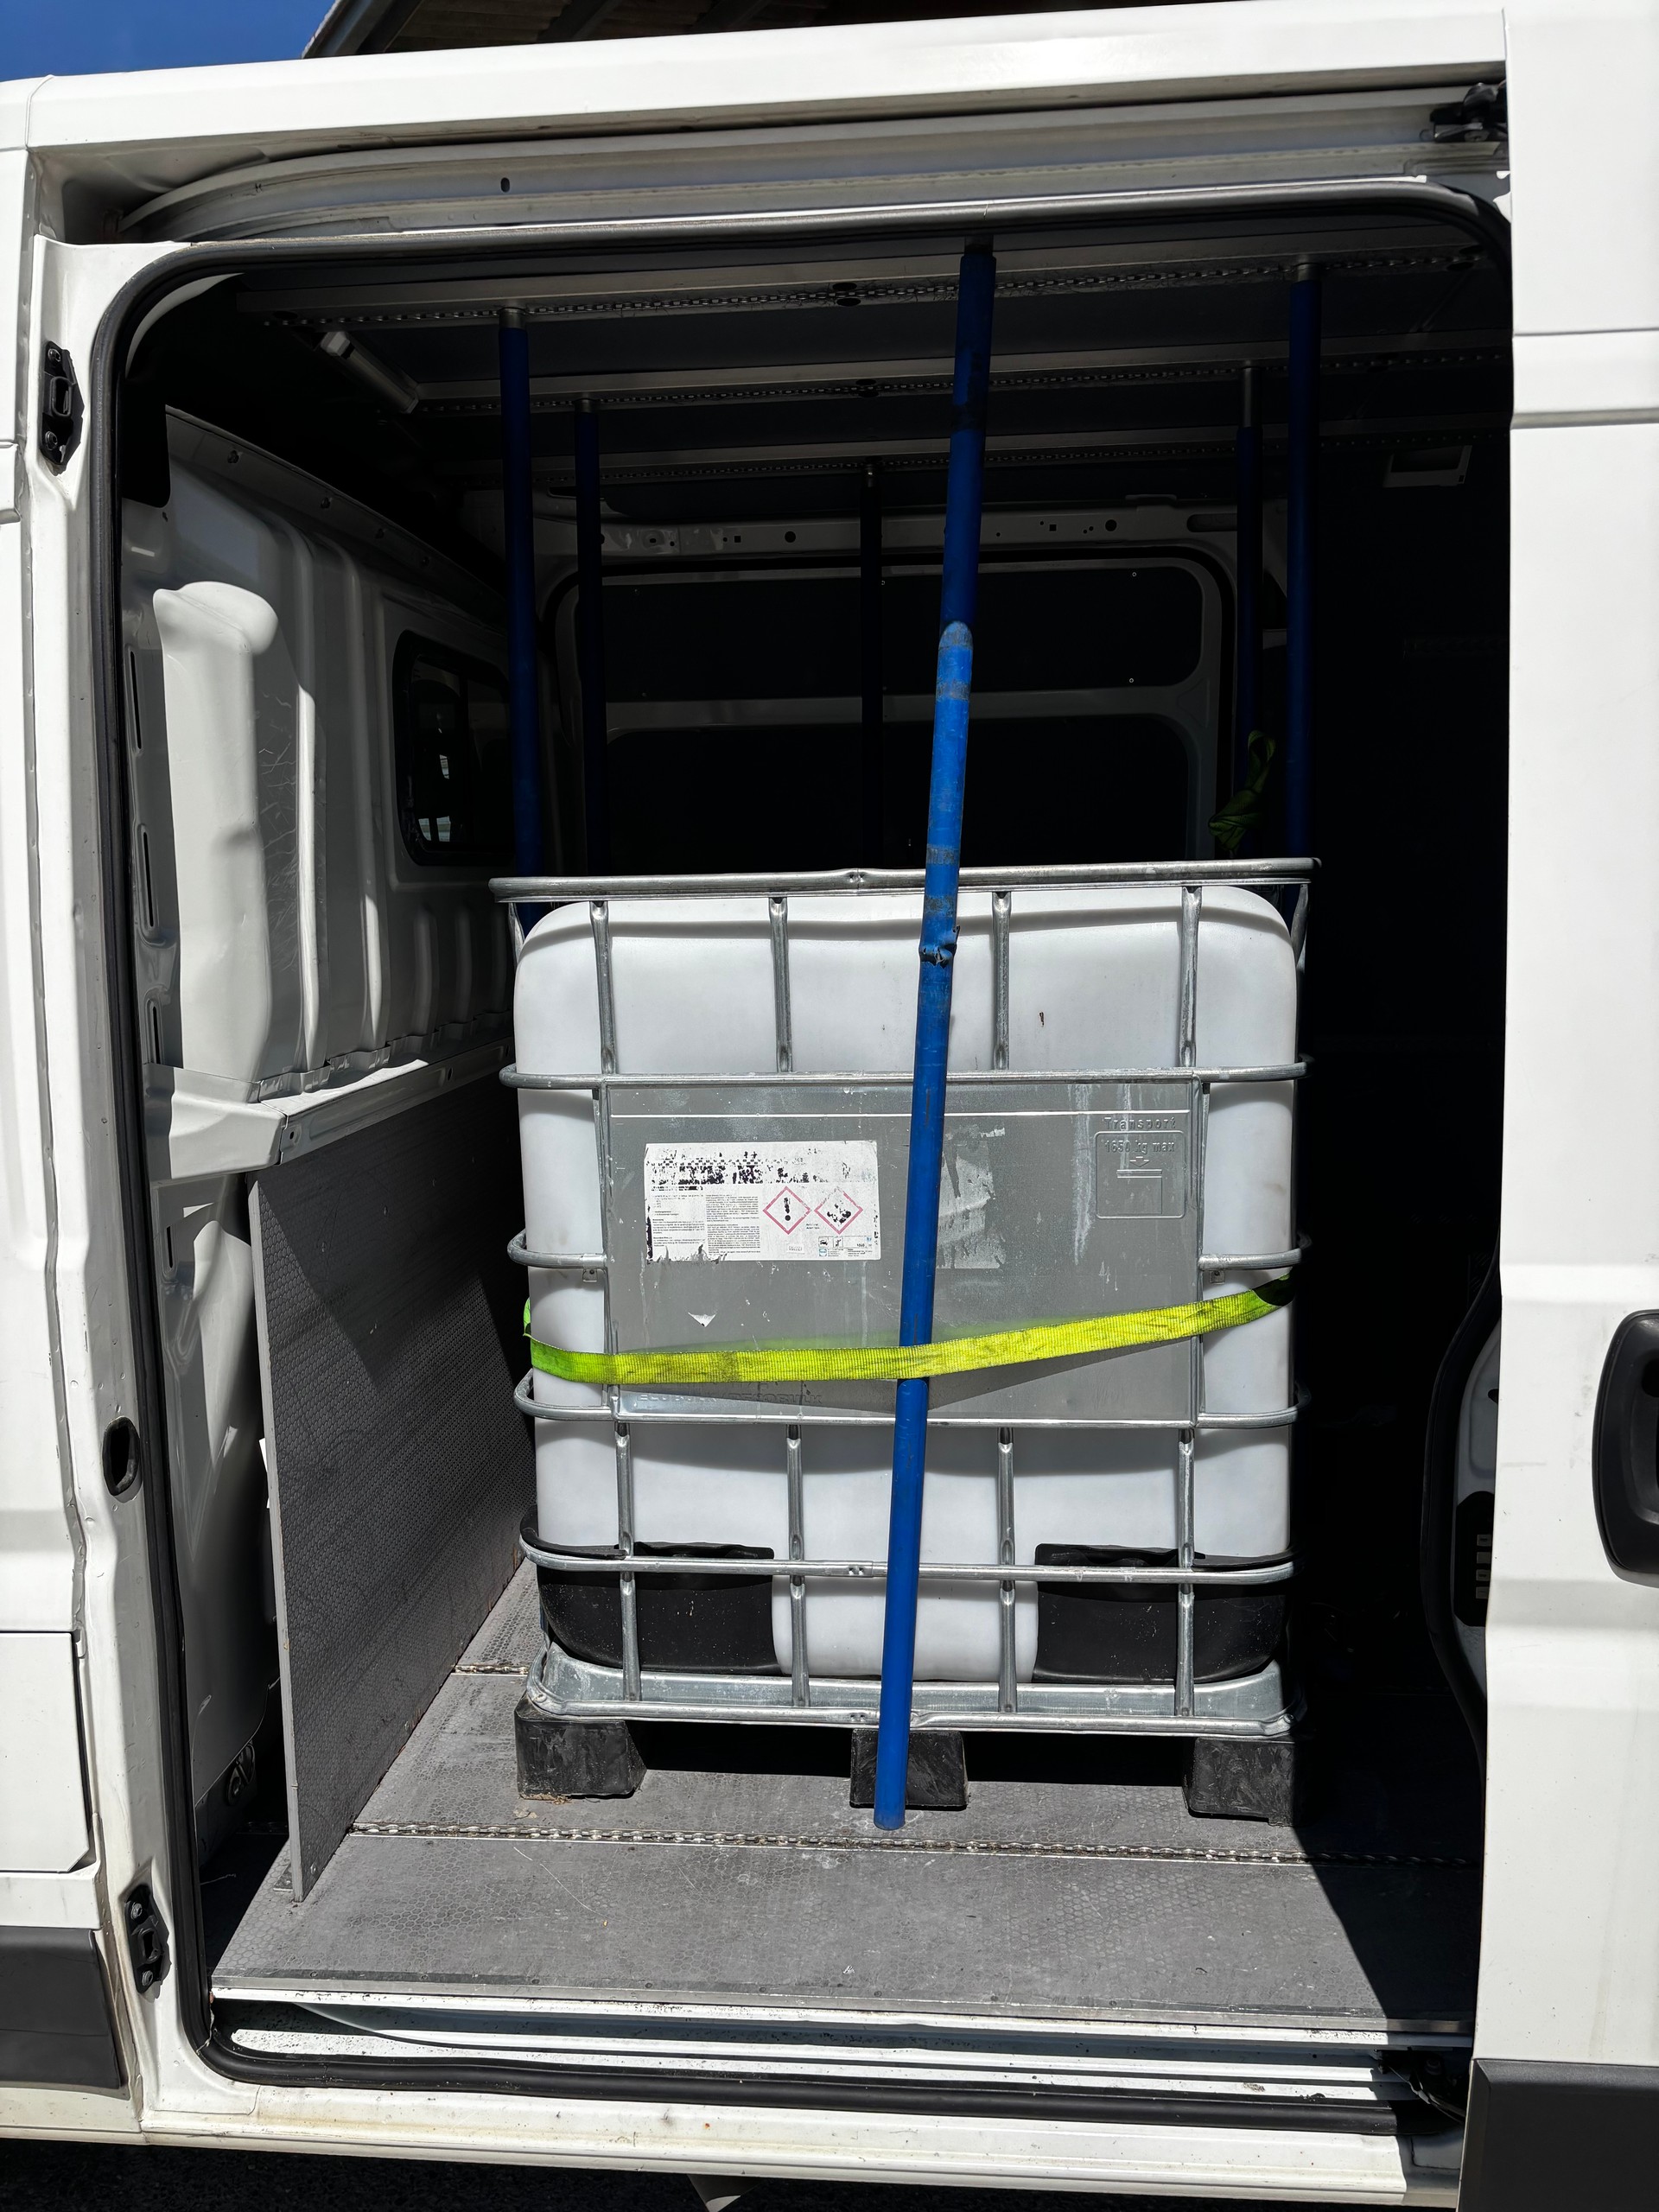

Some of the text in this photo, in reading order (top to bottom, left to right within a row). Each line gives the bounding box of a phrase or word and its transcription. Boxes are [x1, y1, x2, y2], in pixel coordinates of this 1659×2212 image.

[1104, 1116, 1176, 1129] Transport
[1104, 1140, 1176, 1155] 1650 kg max
